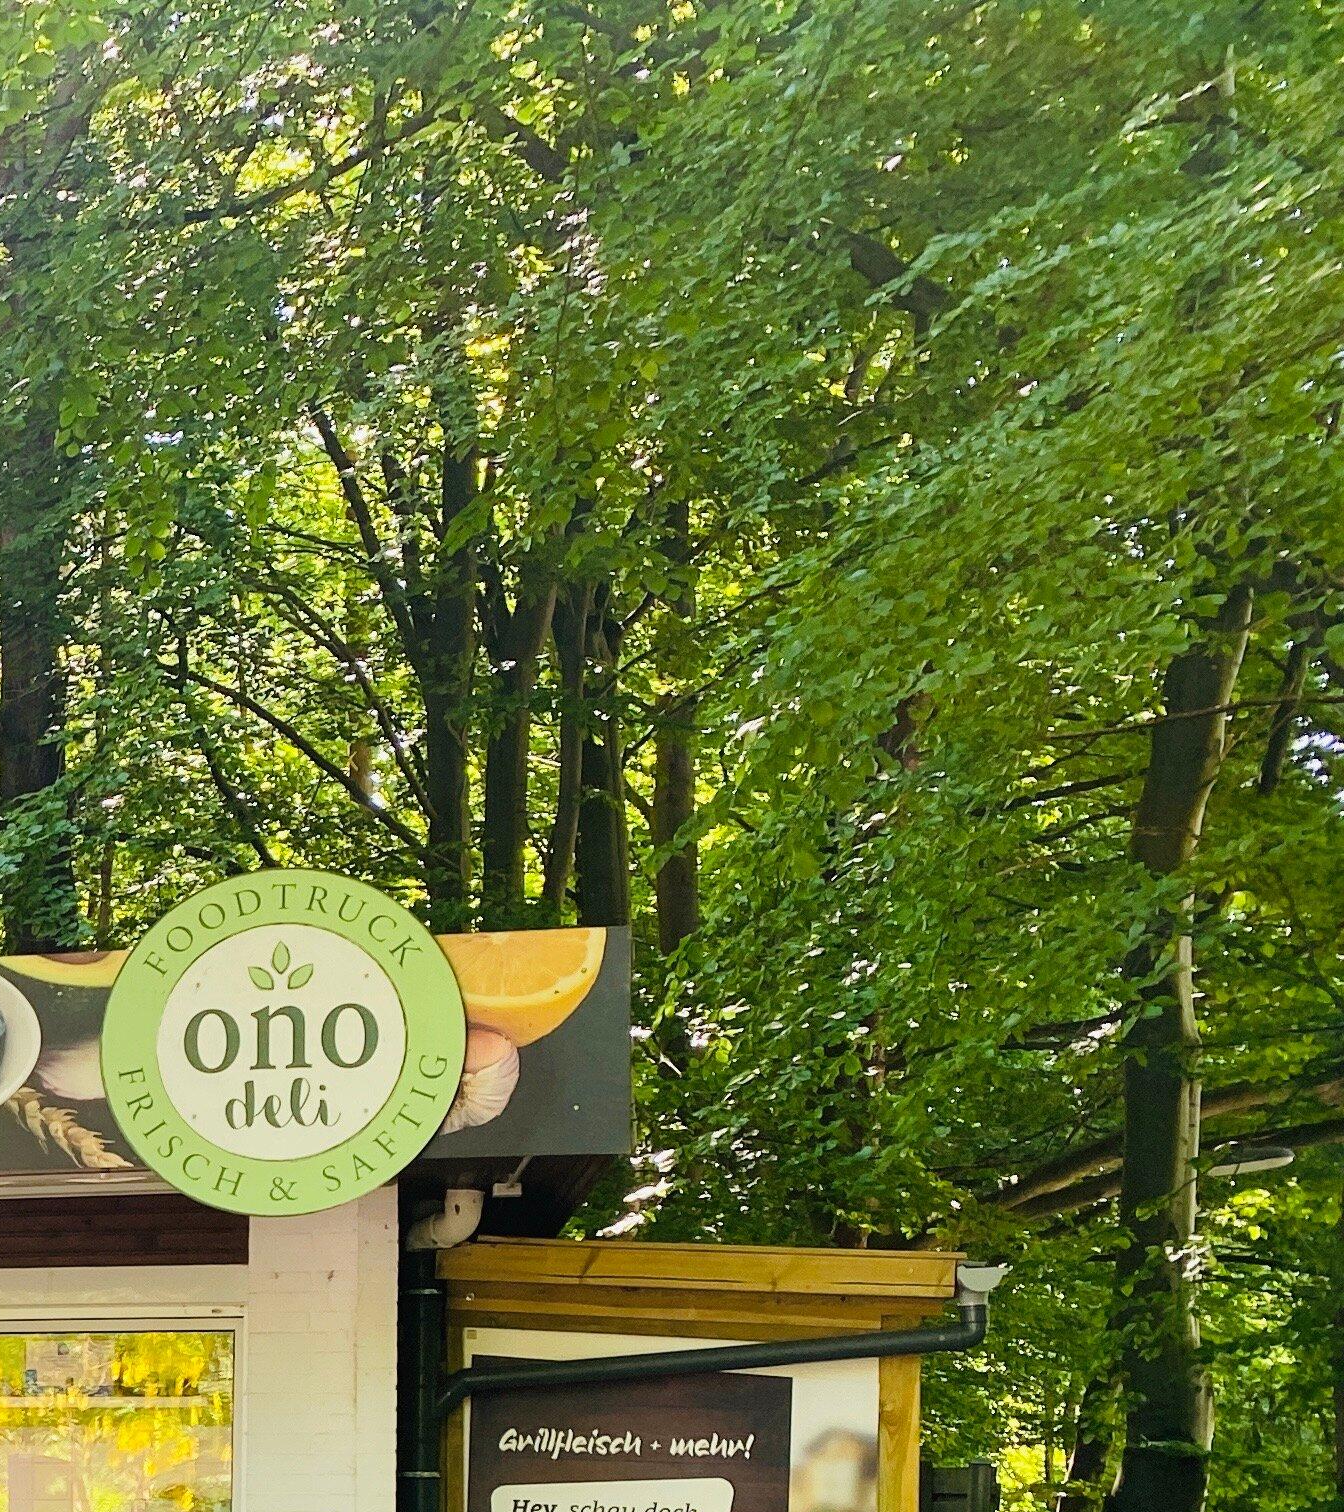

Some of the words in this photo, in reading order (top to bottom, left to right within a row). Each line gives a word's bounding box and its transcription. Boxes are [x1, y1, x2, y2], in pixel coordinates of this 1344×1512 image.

[143, 882, 424, 977] FOODTRUCK
[183, 1002, 380, 1074] ono
[117, 1066, 247, 1198] FRISCH
[268, 1175, 298, 1202] &
[321, 1052, 449, 1193] SAFTIG
[225, 1078, 342, 1130] deli
[498, 1428, 642, 1460] Grillfleisch
[669, 1431, 755, 1460] mehr!
